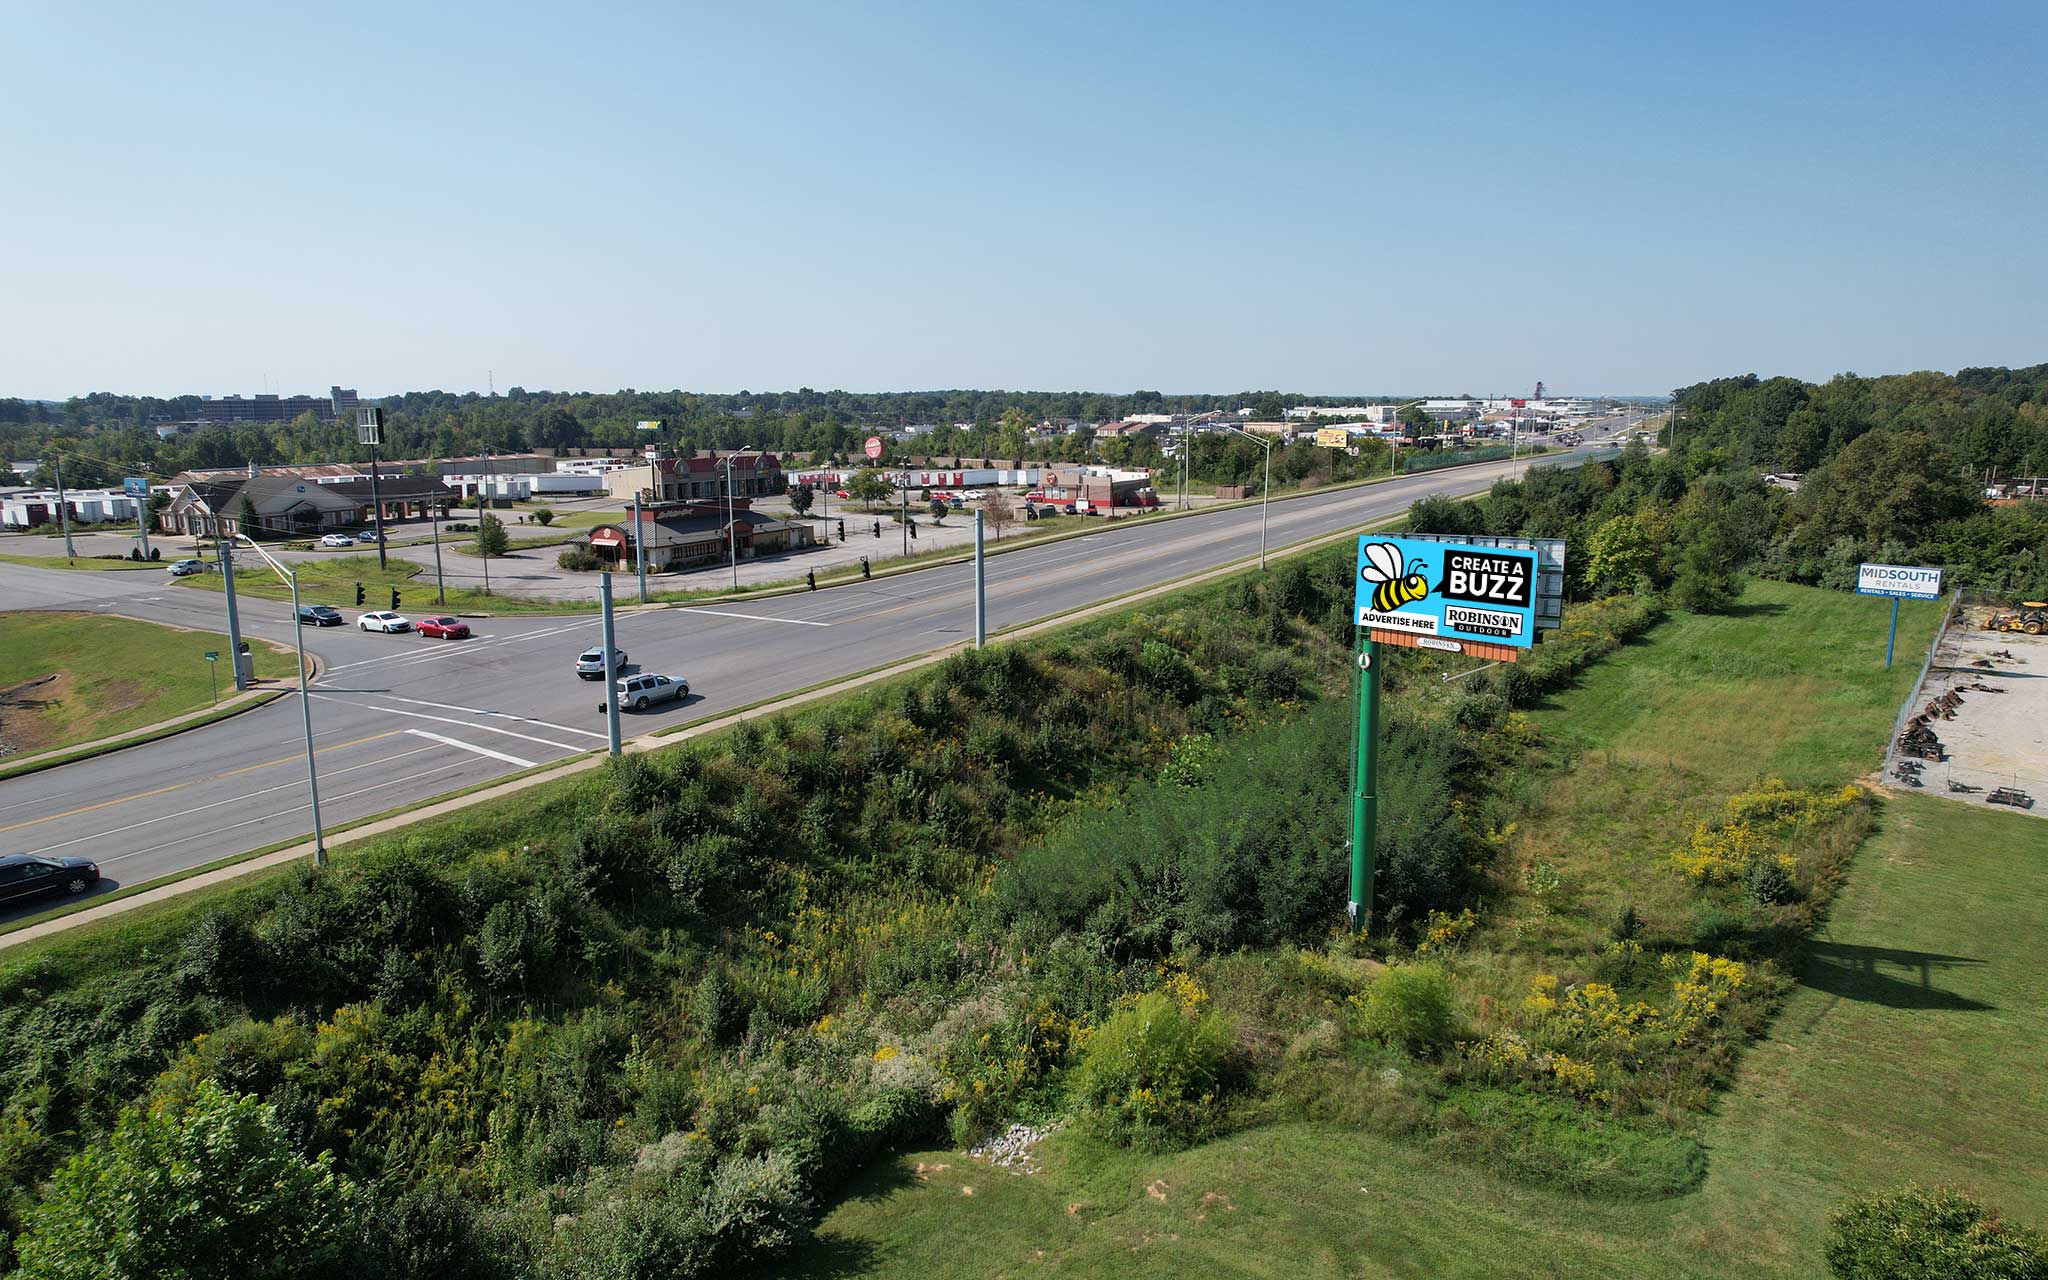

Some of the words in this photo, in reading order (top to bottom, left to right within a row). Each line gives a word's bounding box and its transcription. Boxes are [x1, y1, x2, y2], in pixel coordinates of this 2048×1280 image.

[1451, 556, 1509, 574] CREATE
[1512, 562, 1524, 575] A
[1861, 567, 1938, 583] MIDSOUTH
[1449, 571, 1524, 601] BUZZ
[1875, 580, 1920, 590] RENTALS
[1362, 613, 1411, 627] ADVERTISE
[1412, 620, 1435, 630] HERE
[1448, 609, 1519, 628] ROBINSON
[1458, 624, 1507, 637] OUTDOOR
